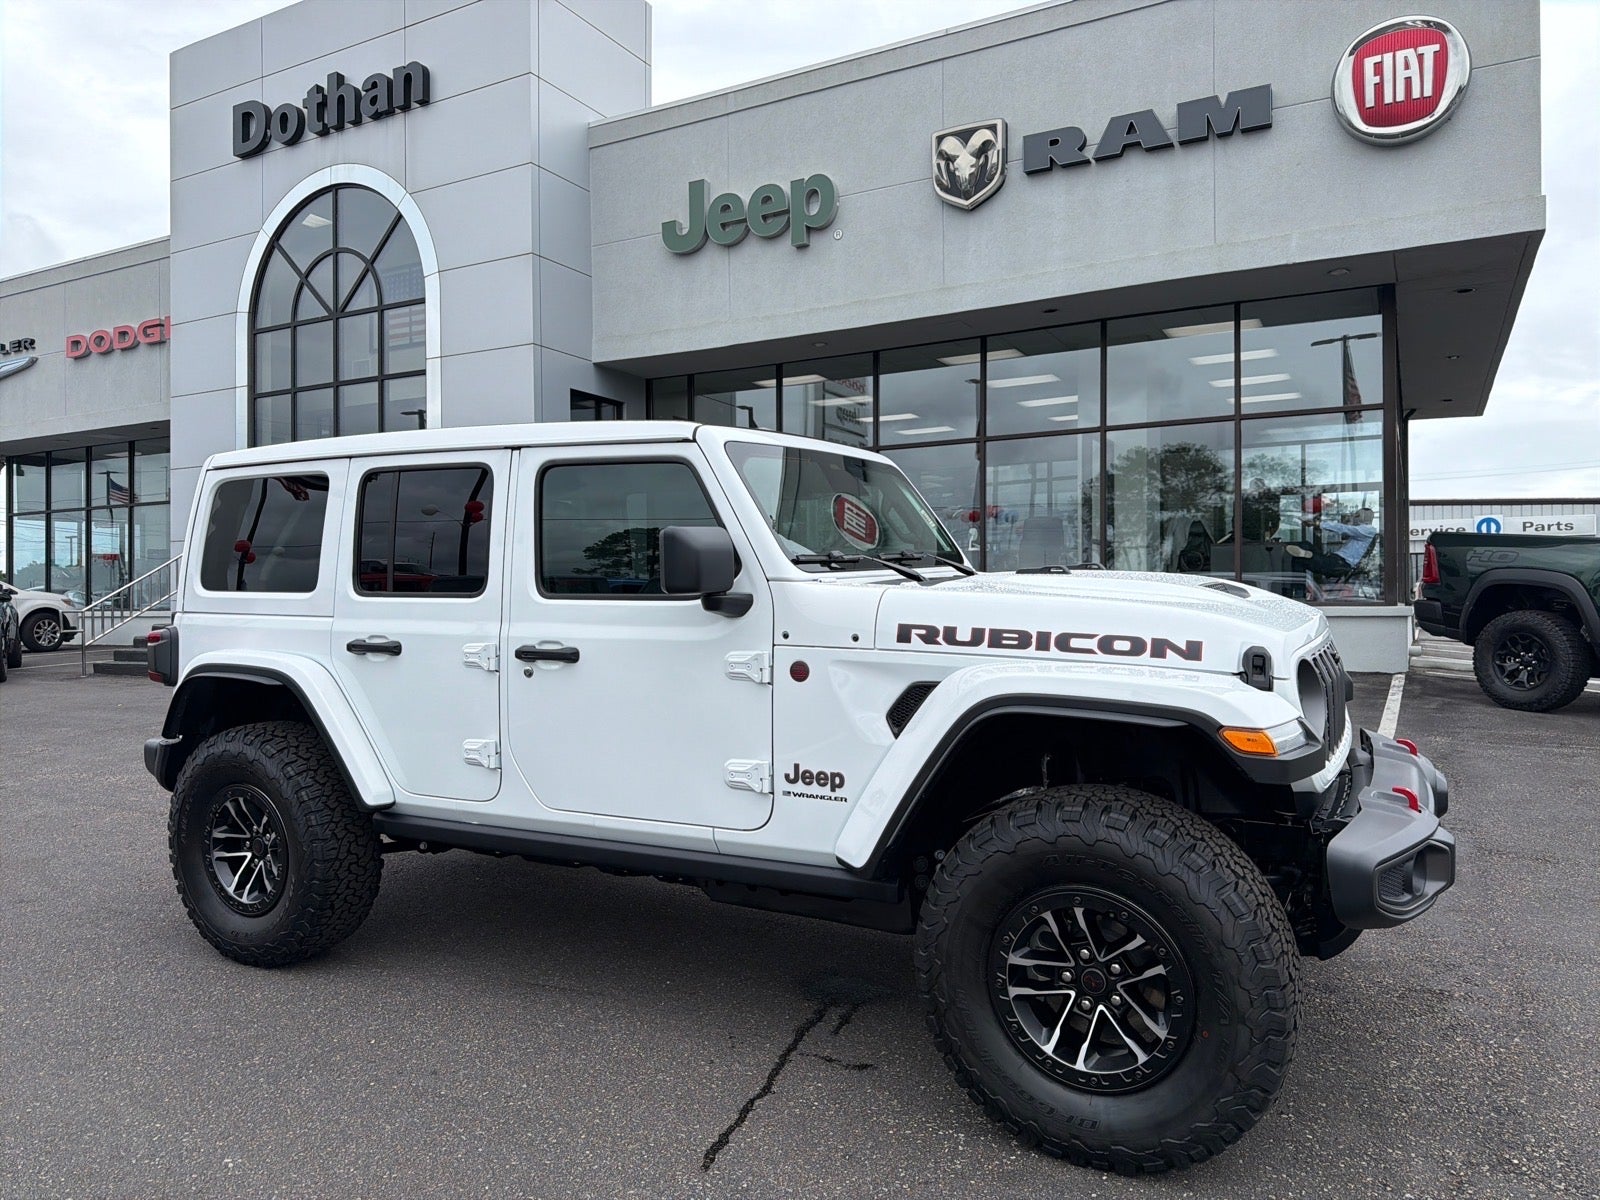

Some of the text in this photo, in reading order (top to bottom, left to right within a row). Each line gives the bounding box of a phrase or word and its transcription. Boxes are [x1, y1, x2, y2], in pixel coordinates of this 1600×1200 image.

[1363, 43, 1441, 110] FIAT
[232, 60, 431, 160] Dothan
[1022, 83, 1273, 176] RAM
[661, 173, 840, 255] Jeep
[1409, 524, 1467, 537] ervice
[1522, 521, 1575, 533] Parts
[896, 622, 1204, 662] RUBICON
[784, 762, 846, 793] Jeep
[792, 790, 848, 803] WRANGLER
